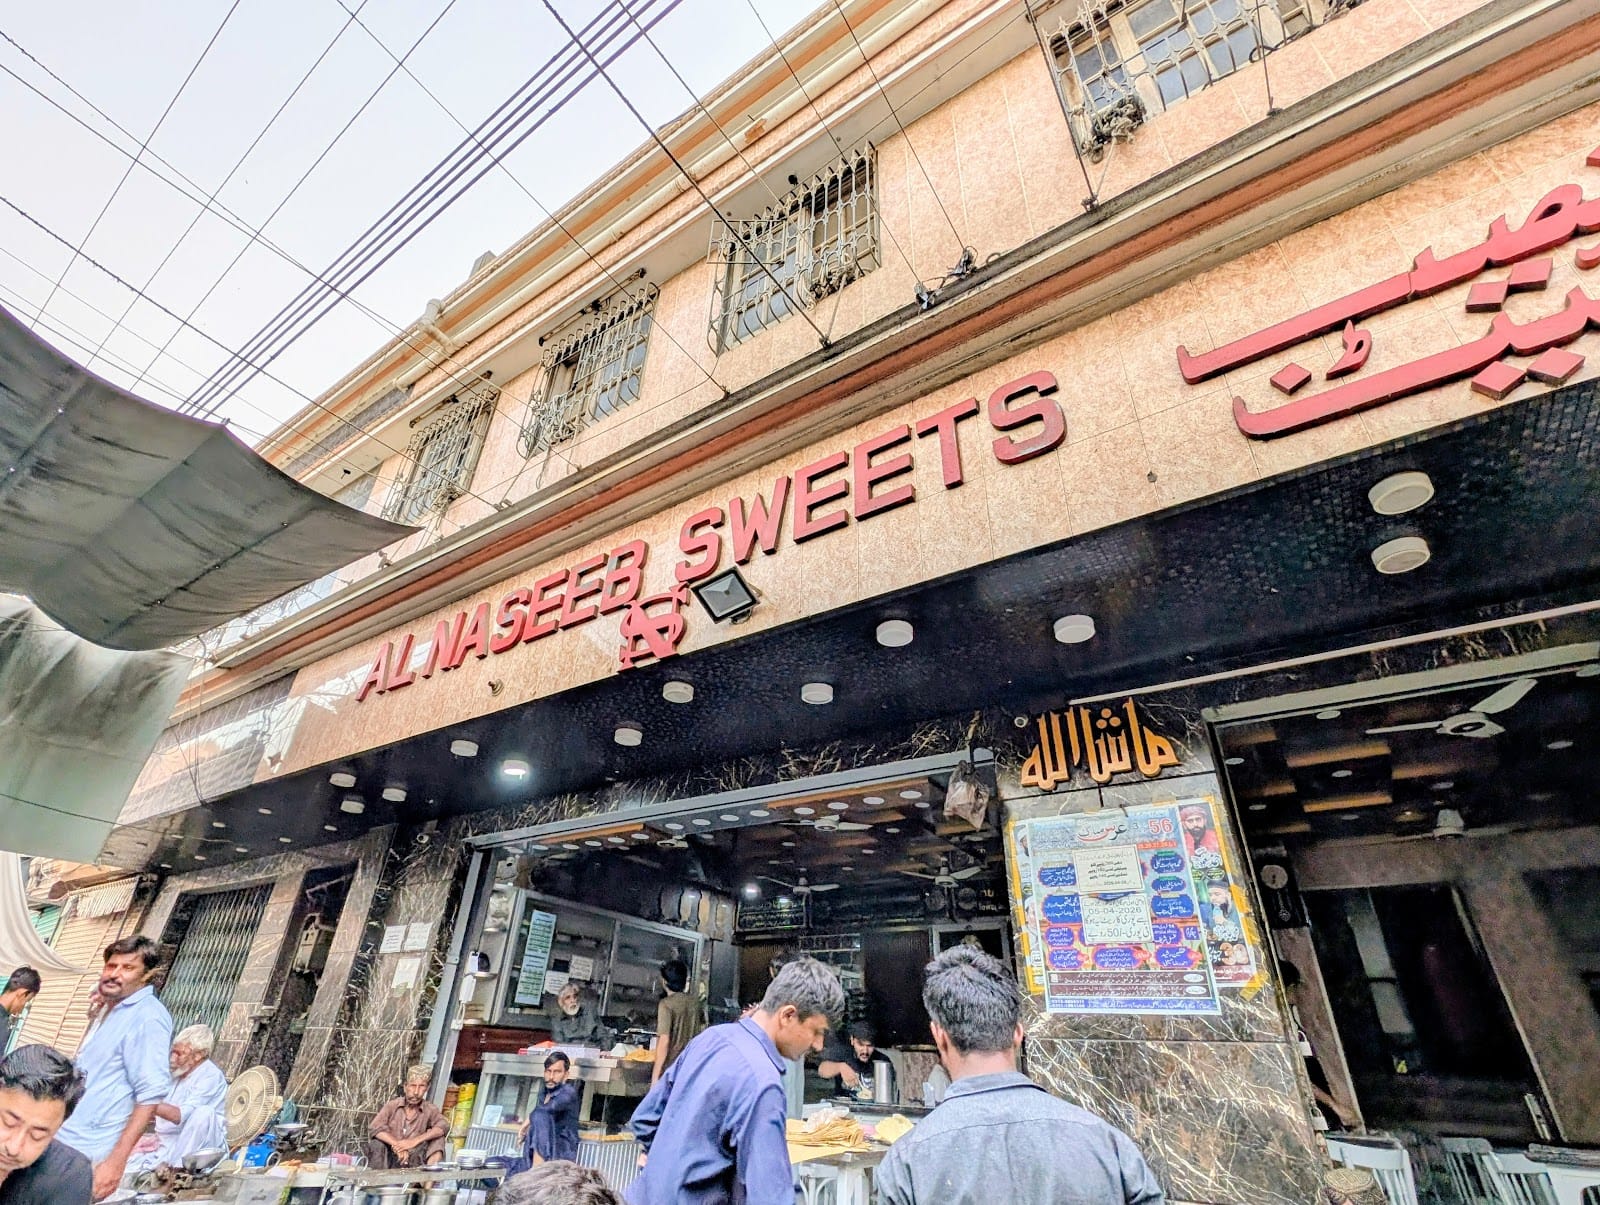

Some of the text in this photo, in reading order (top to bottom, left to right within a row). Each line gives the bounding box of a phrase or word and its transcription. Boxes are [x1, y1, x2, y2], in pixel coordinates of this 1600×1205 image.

[356, 371, 1068, 702] AL NASEEB SWEETS
[1149, 818, 1173, 834] 56
